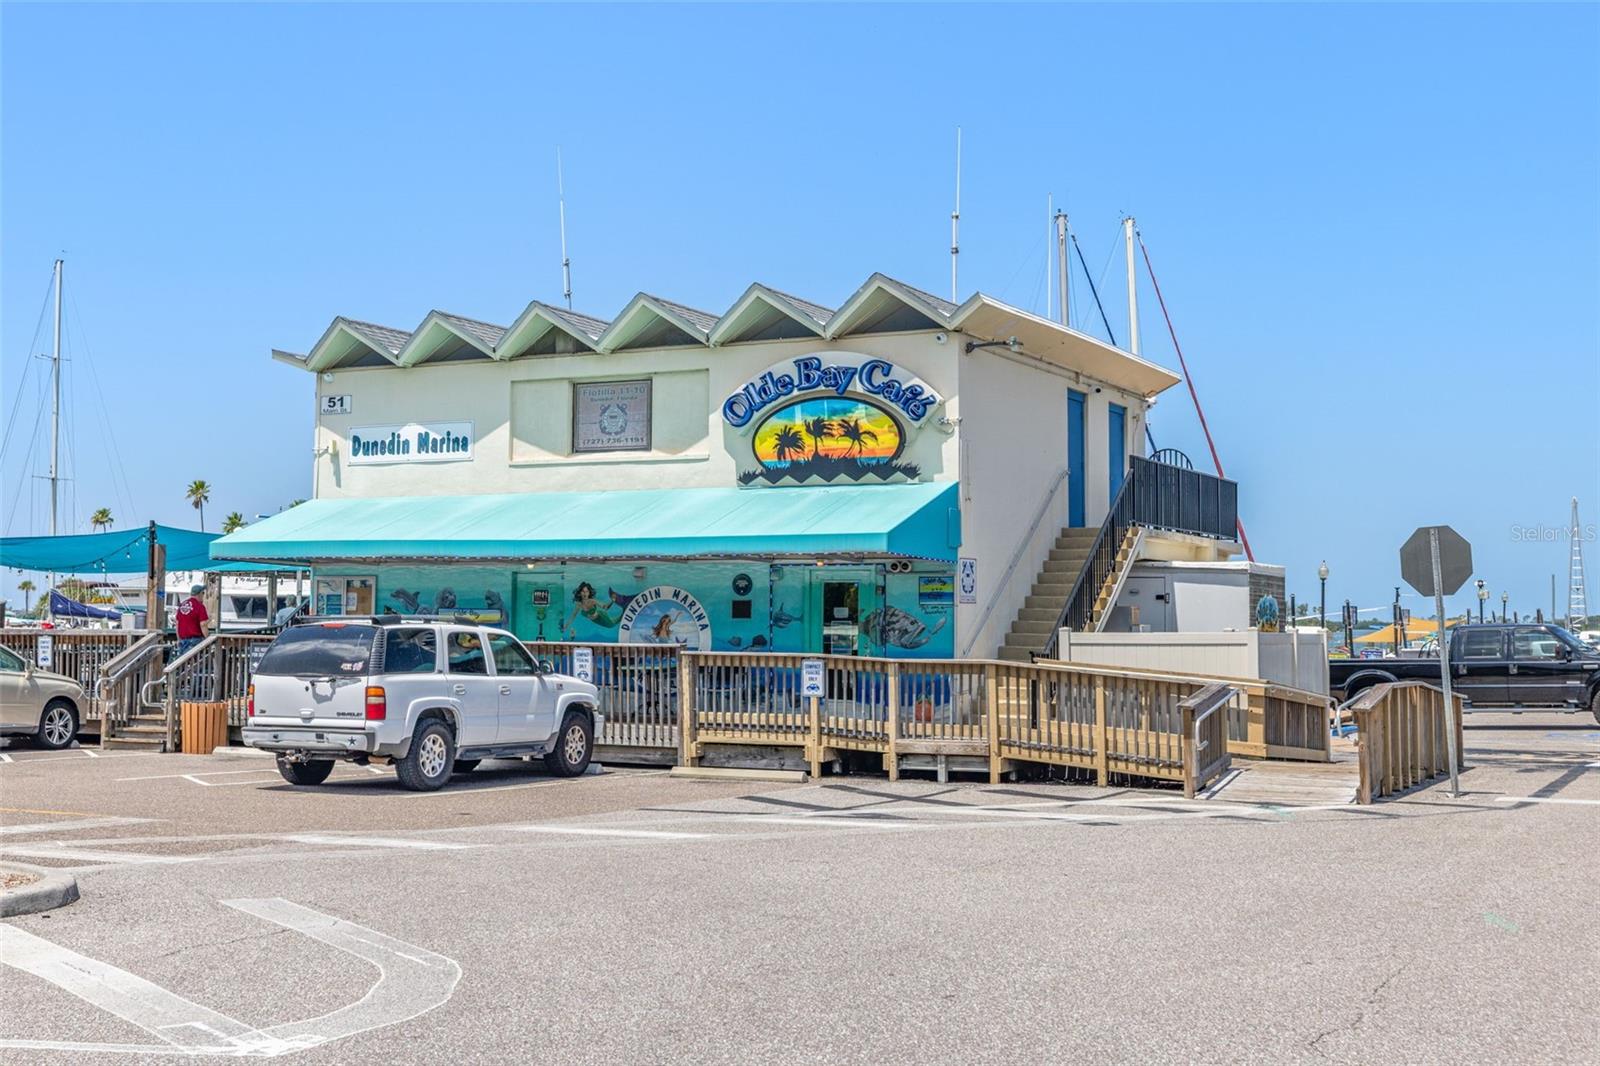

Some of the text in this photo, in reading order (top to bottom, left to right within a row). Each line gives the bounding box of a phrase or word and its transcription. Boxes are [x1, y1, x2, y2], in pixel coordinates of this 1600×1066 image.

[327, 396, 344, 408] 51
[722, 356, 938, 428] Olde Bay Café
[351, 430, 469, 457] Dunedin Marina
[621, 587, 709, 632] DUNEDIN MARINA
